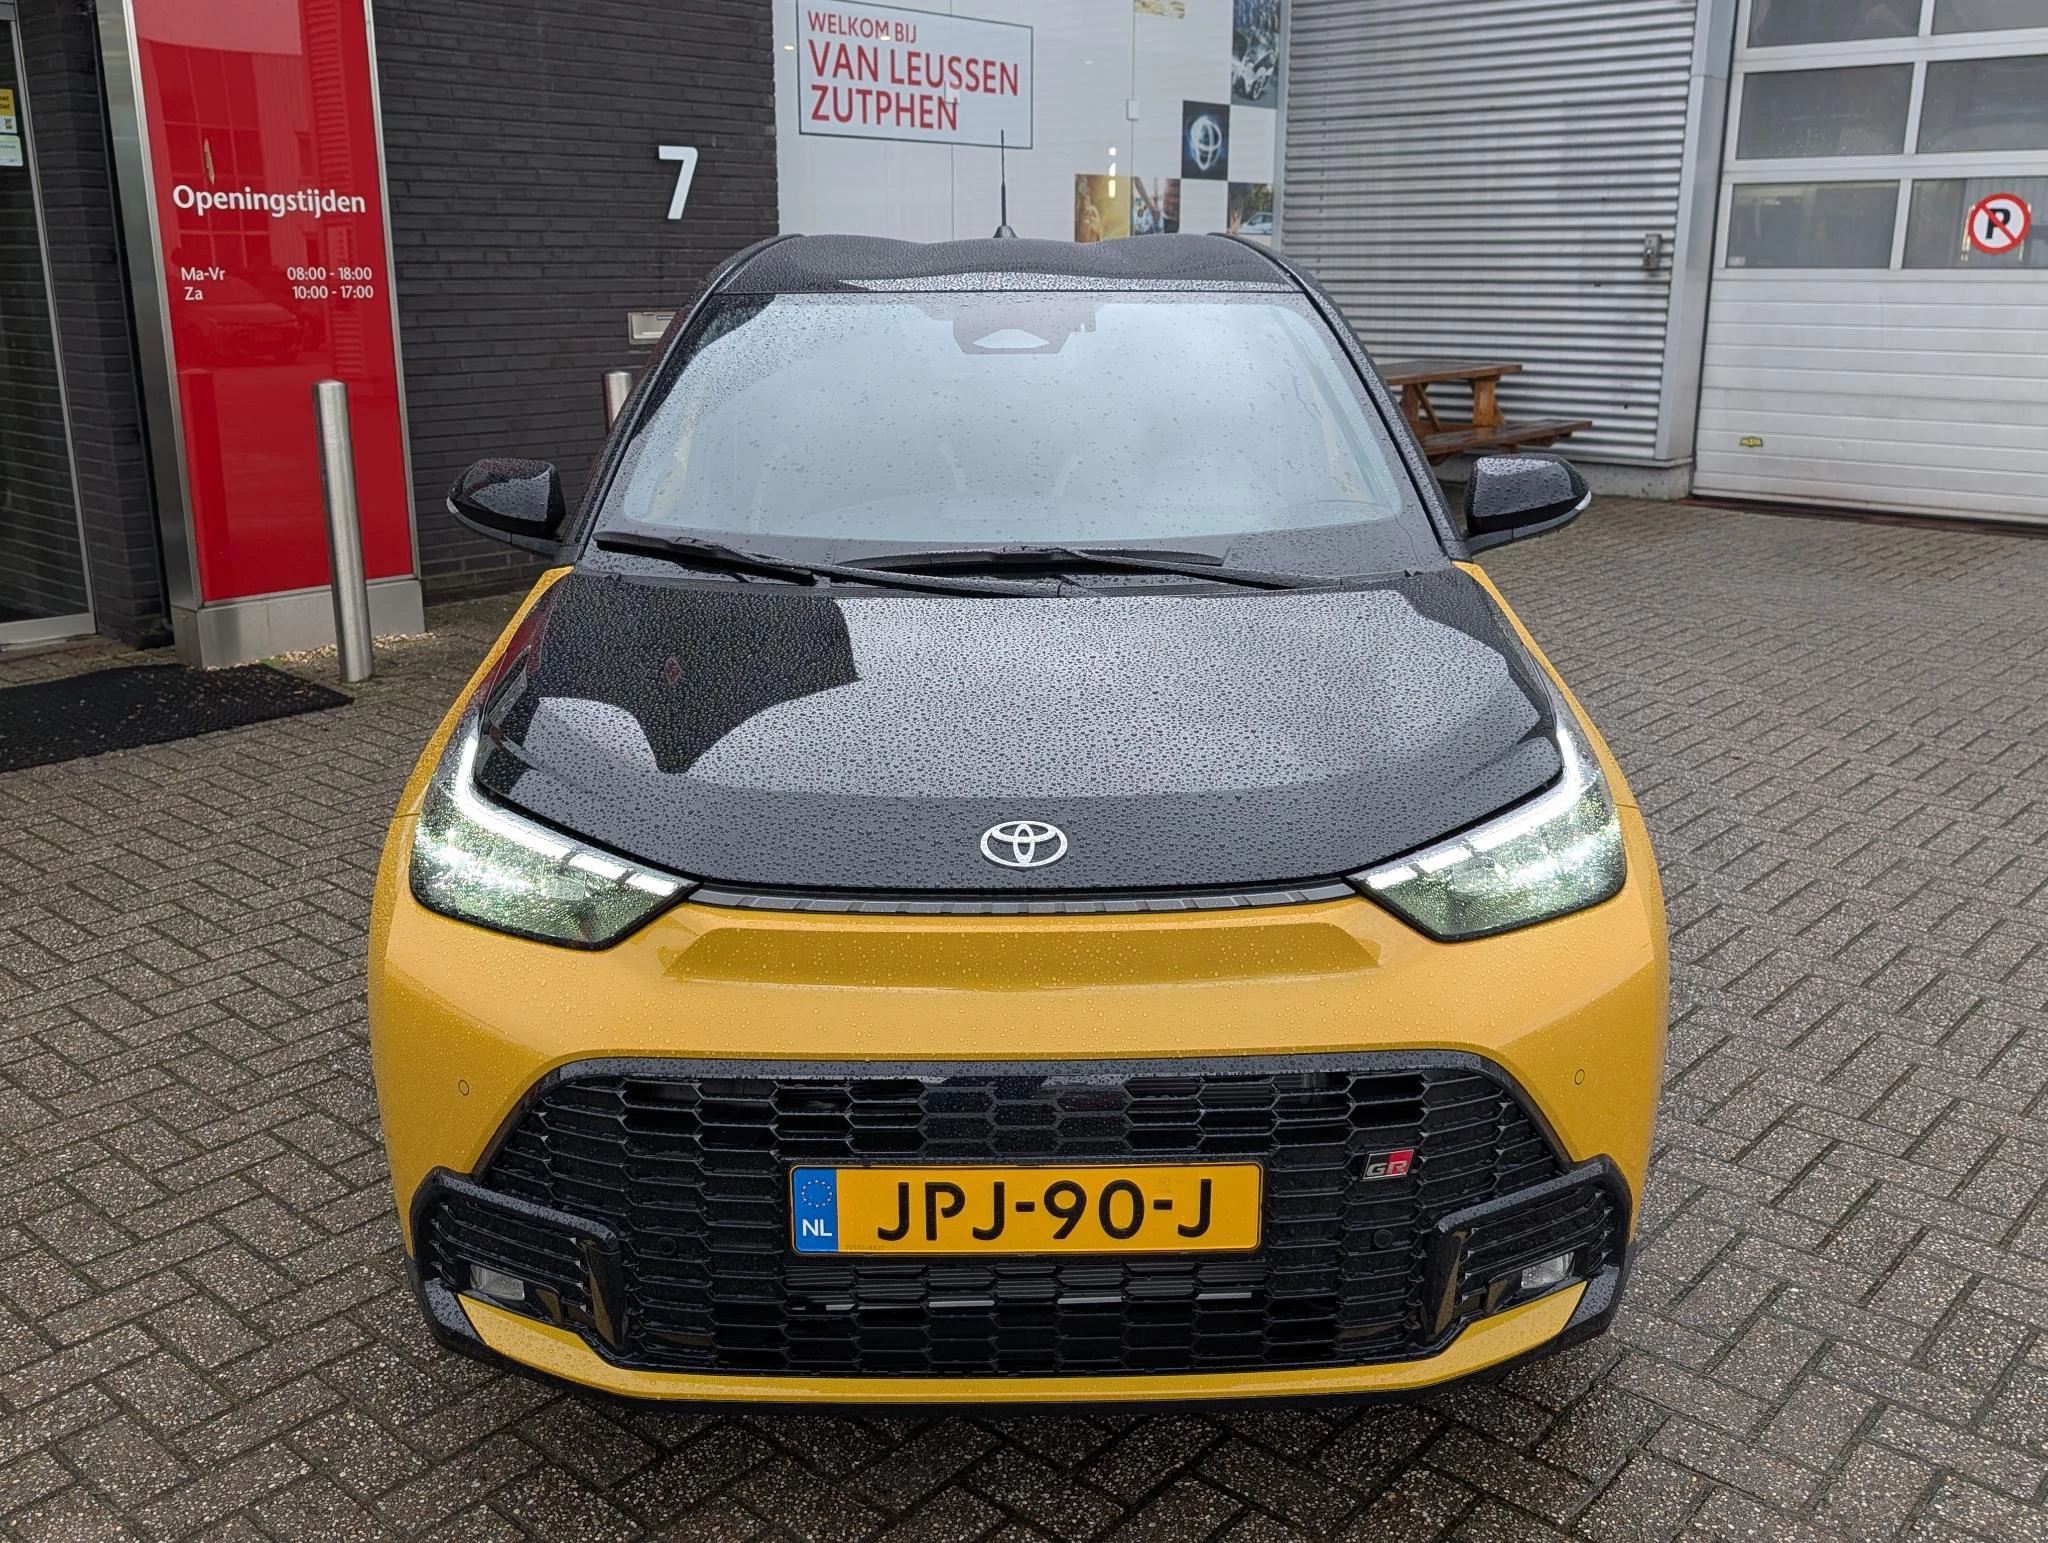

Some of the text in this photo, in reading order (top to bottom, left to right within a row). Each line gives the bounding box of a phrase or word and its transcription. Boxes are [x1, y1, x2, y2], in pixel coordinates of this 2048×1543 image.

[808, 11, 918, 44] WELKOM BIJ
[808, 39, 1019, 96] VAN LEUSSEN
[811, 84, 958, 131] ZUTPHEN
[658, 145, 699, 220] 7
[172, 185, 366, 218] Openingstijden
[1985, 208, 2011, 239] P
[181, 266, 226, 281] Ma-Vr
[287, 266, 327, 281] 08:00
[337, 266, 373, 281] 18:00
[184, 286, 204, 301] Za
[292, 285, 329, 300] 10:00
[340, 285, 374, 299] 17:00
[1366, 1160, 1408, 1177] GR
[877, 1178, 1212, 1242] JPJ-90-J
[802, 1218, 833, 1237] NL
